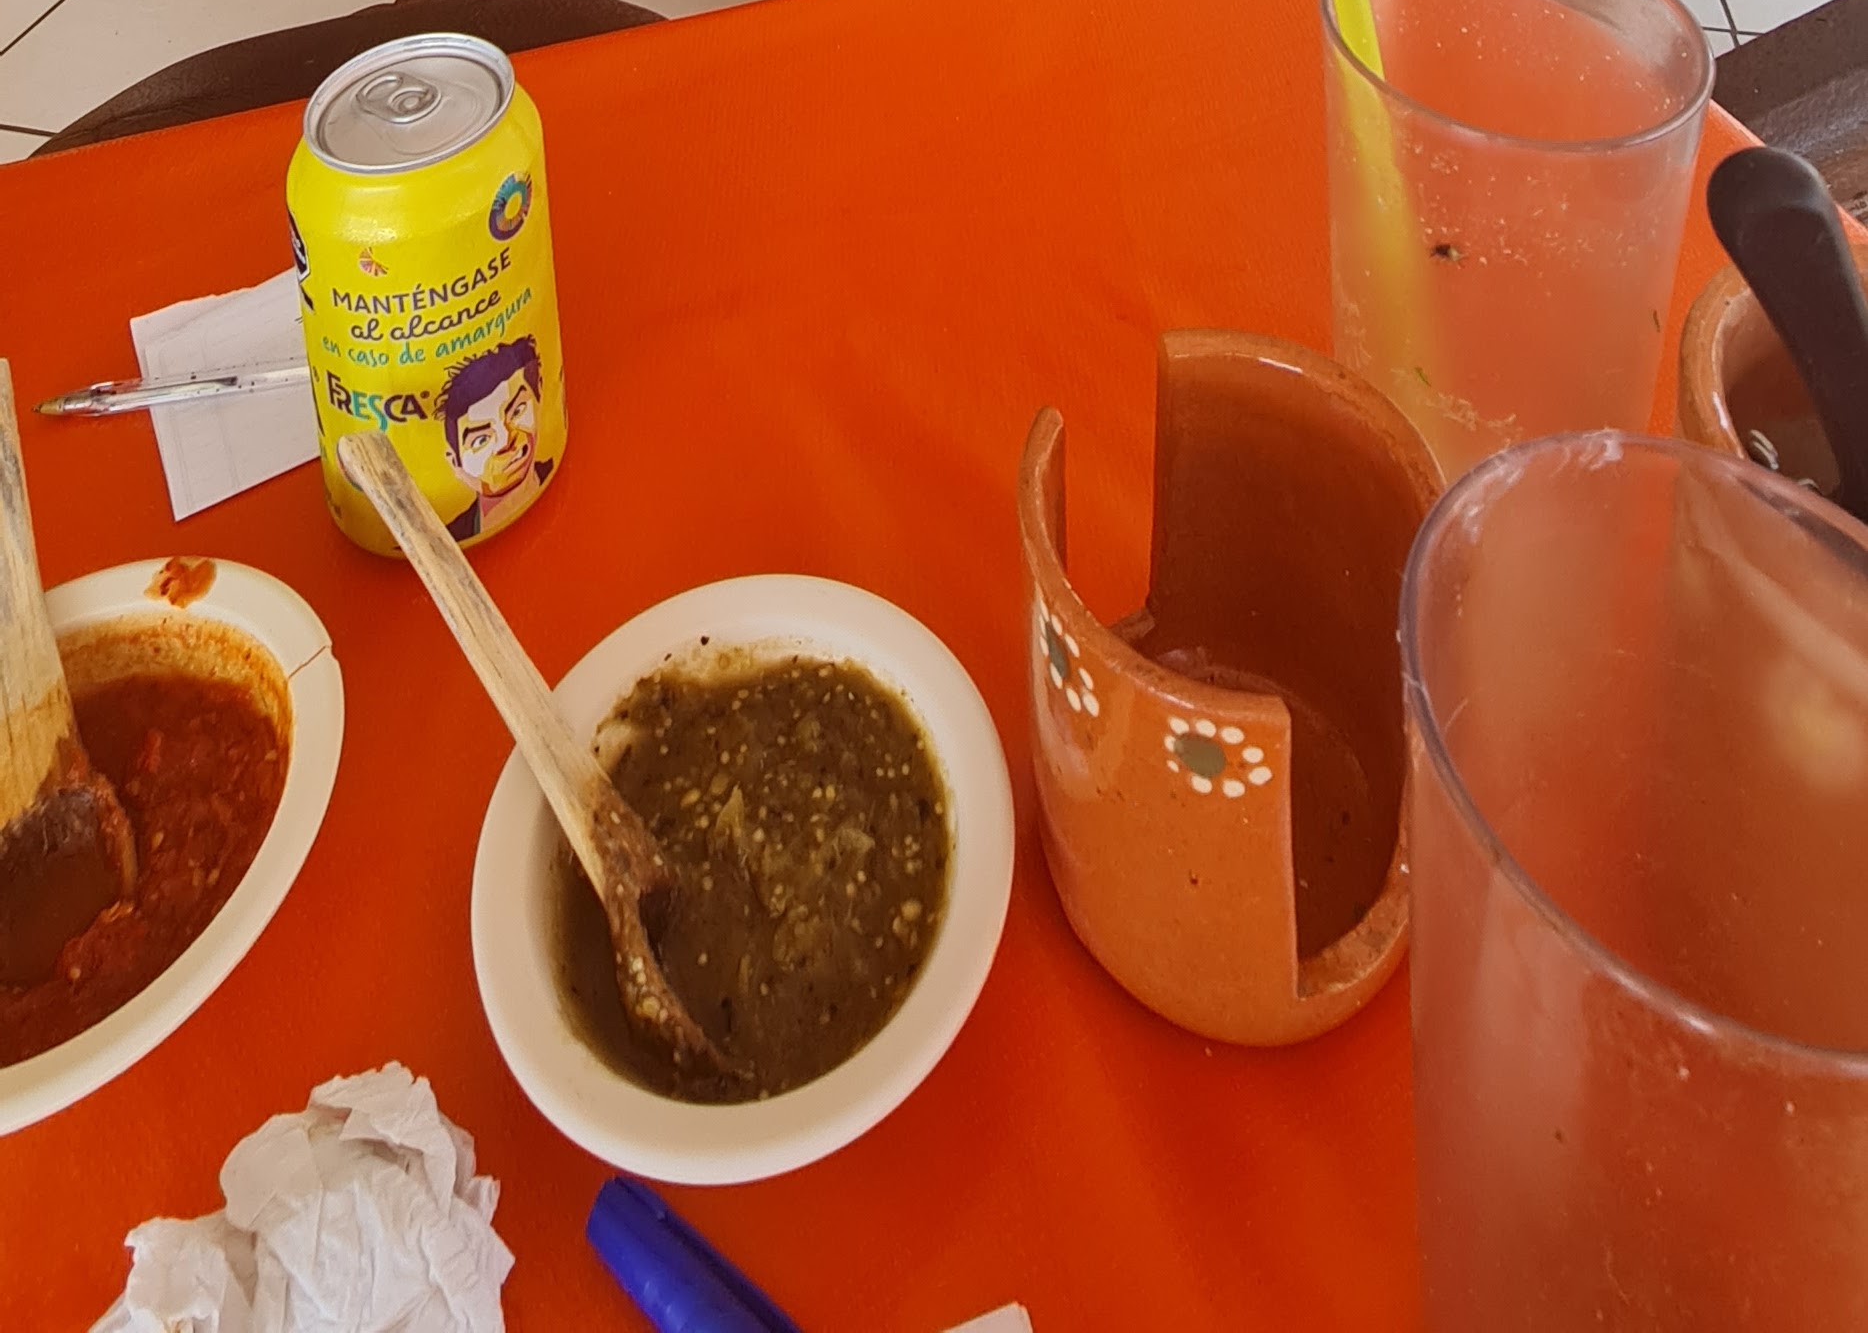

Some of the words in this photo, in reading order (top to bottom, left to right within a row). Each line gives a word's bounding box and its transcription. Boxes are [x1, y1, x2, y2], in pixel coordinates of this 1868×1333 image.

[332, 247, 512, 314] MANTÉNGASE
[322, 336, 341, 358] en
[348, 346, 390, 367] caso
[399, 341, 426, 365] de
[436, 287, 533, 358] amargura
[350, 318, 384, 341] al
[390, 290, 502, 342] alcance
